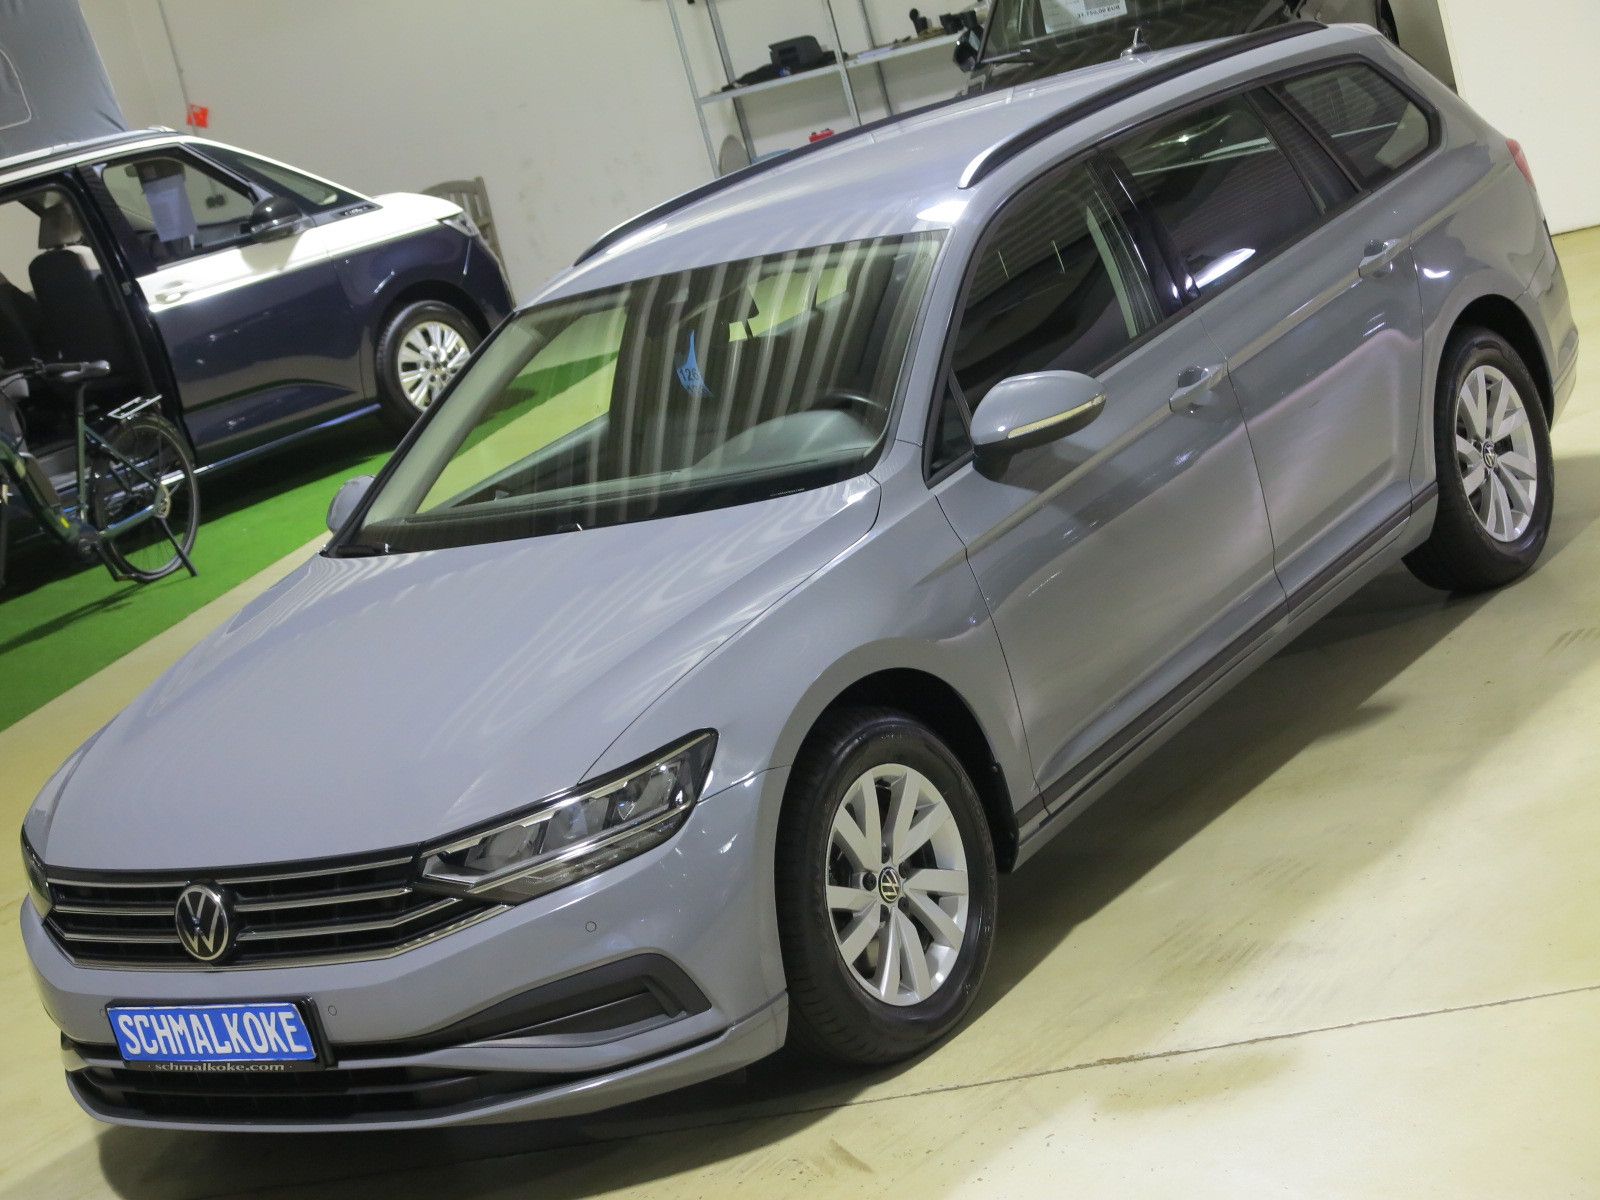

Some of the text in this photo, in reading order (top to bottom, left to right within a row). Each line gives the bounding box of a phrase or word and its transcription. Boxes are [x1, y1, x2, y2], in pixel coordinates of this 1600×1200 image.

[177, 886, 229, 960] VW
[117, 1011, 308, 1056] SCHMALKOKE
[153, 1062, 286, 1073] schmalkoke.com
